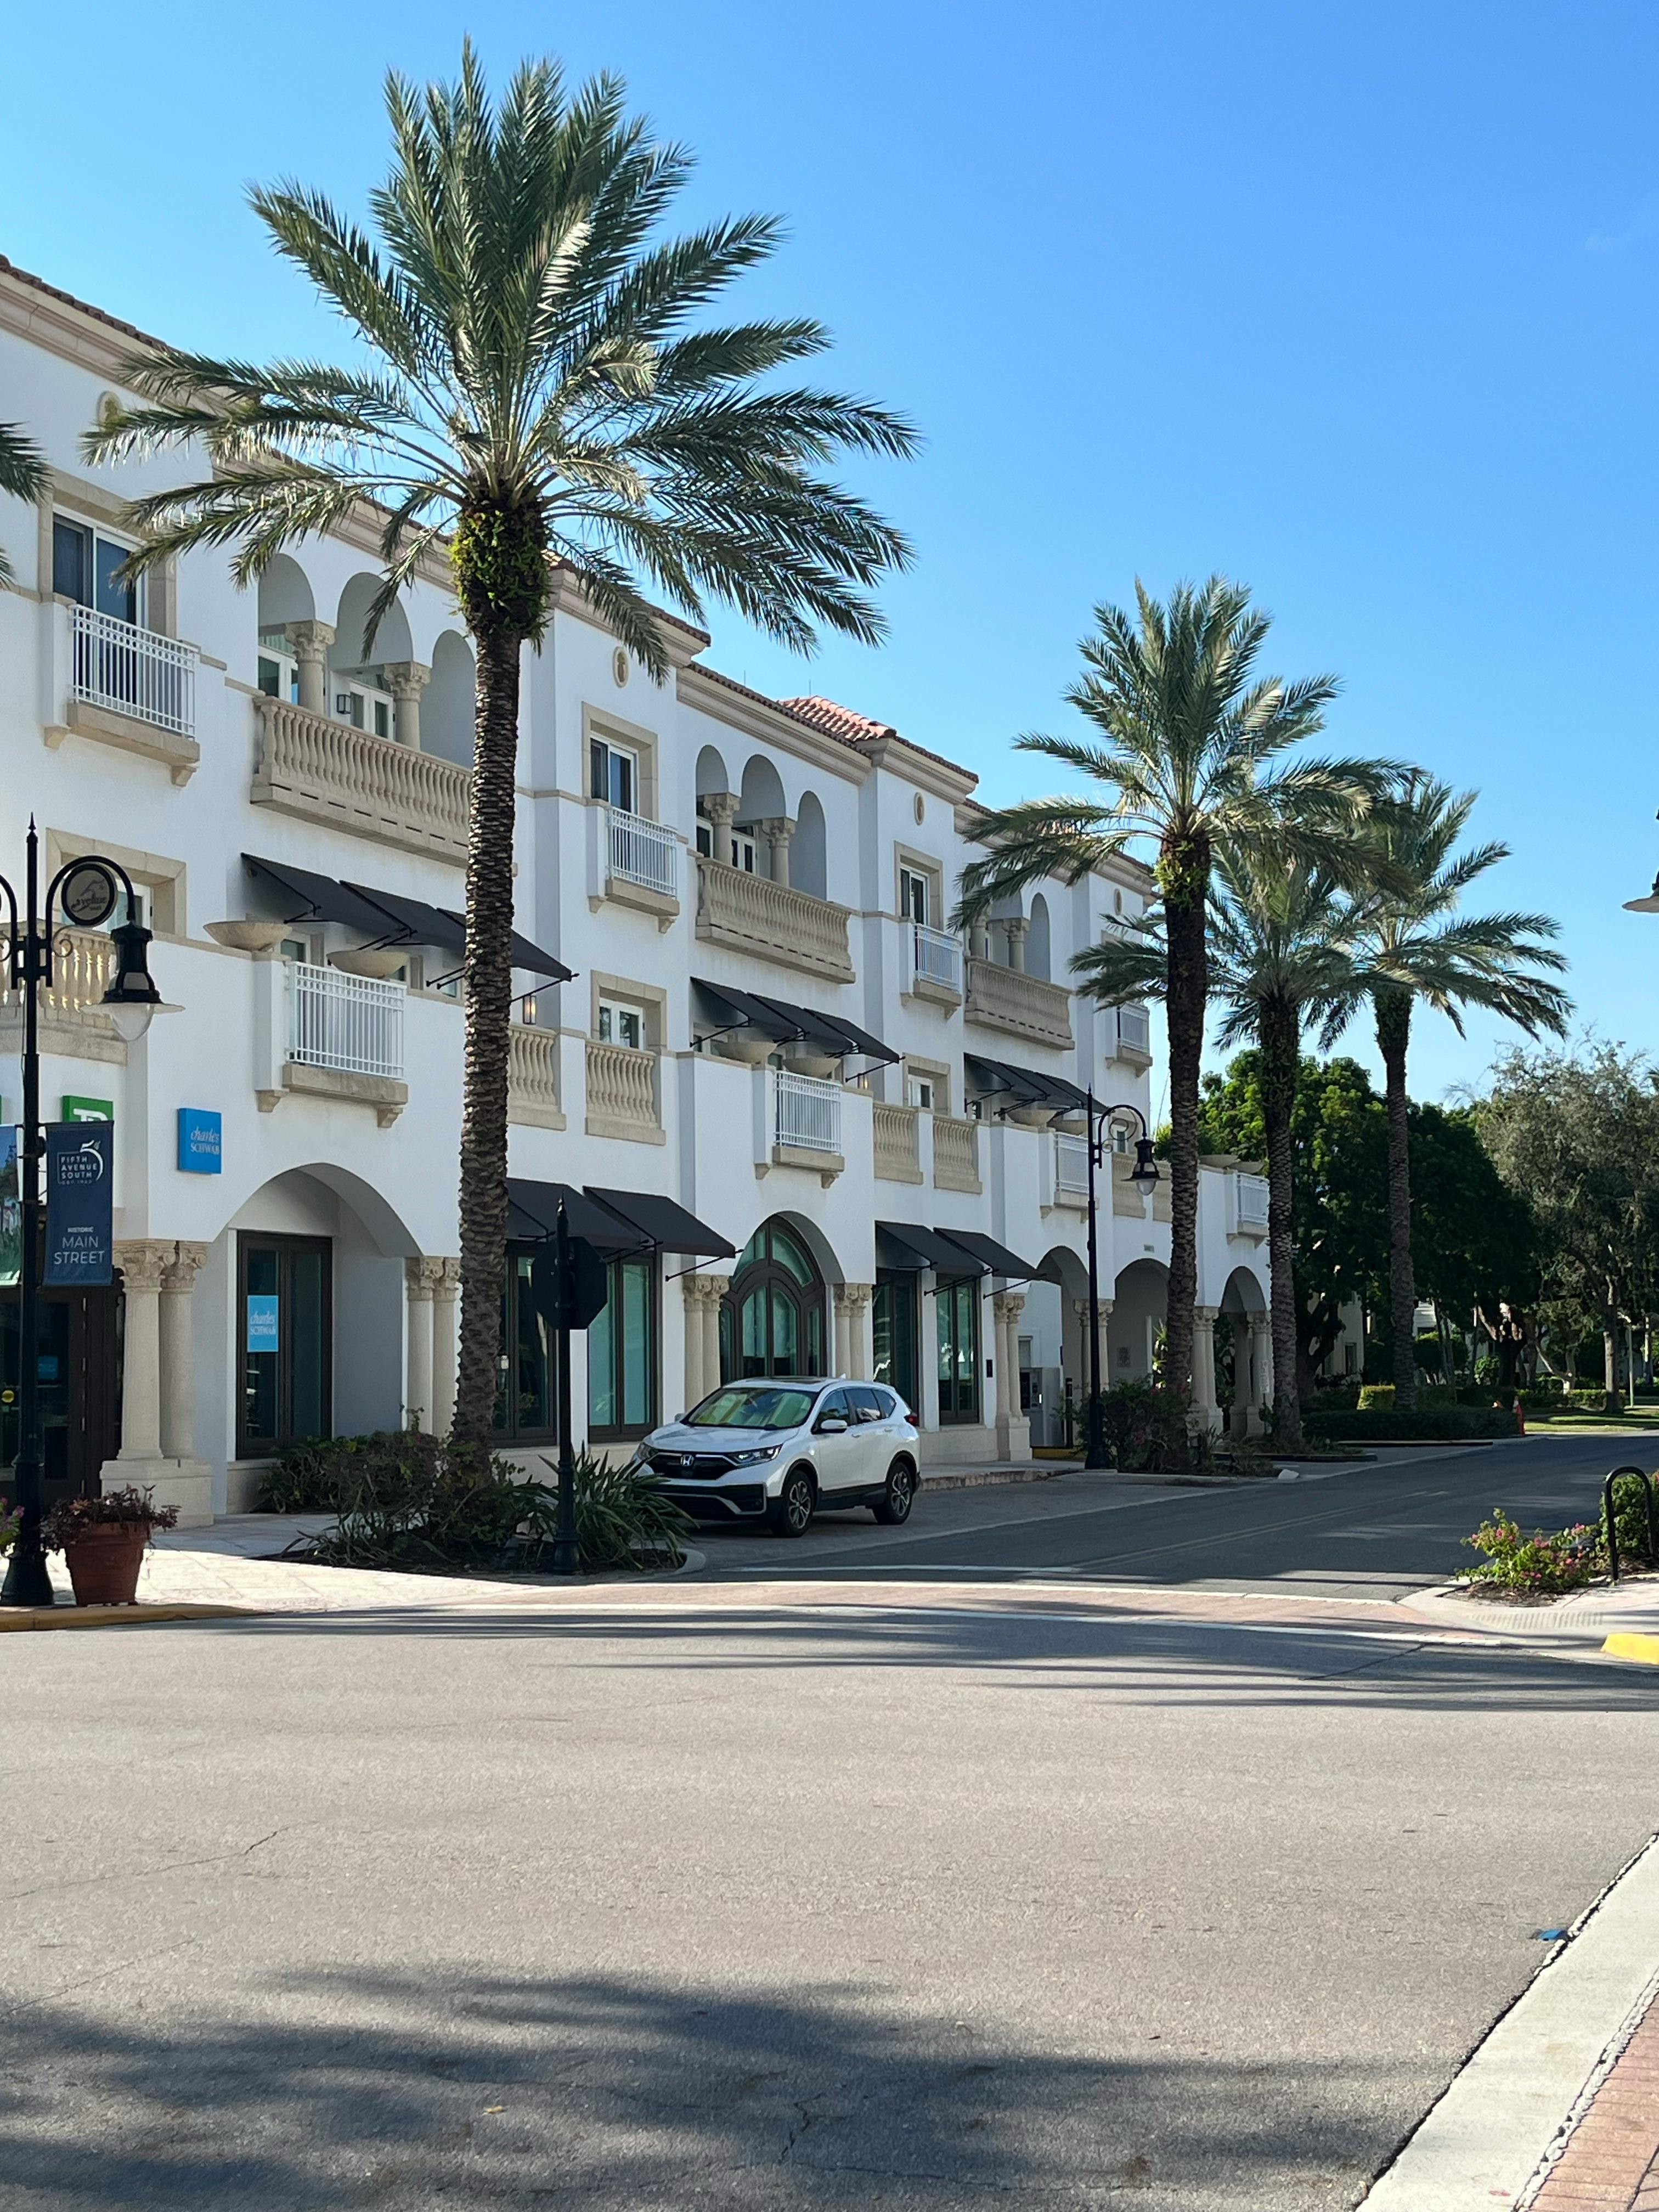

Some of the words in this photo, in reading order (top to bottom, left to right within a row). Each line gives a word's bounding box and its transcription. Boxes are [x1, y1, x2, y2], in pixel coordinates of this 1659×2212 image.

[190, 1126, 220, 1143] charles
[190, 1142, 220, 1155] SCHWAB
[62, 1235, 98, 1249] MAIN
[54, 1251, 105, 1265] STREET
